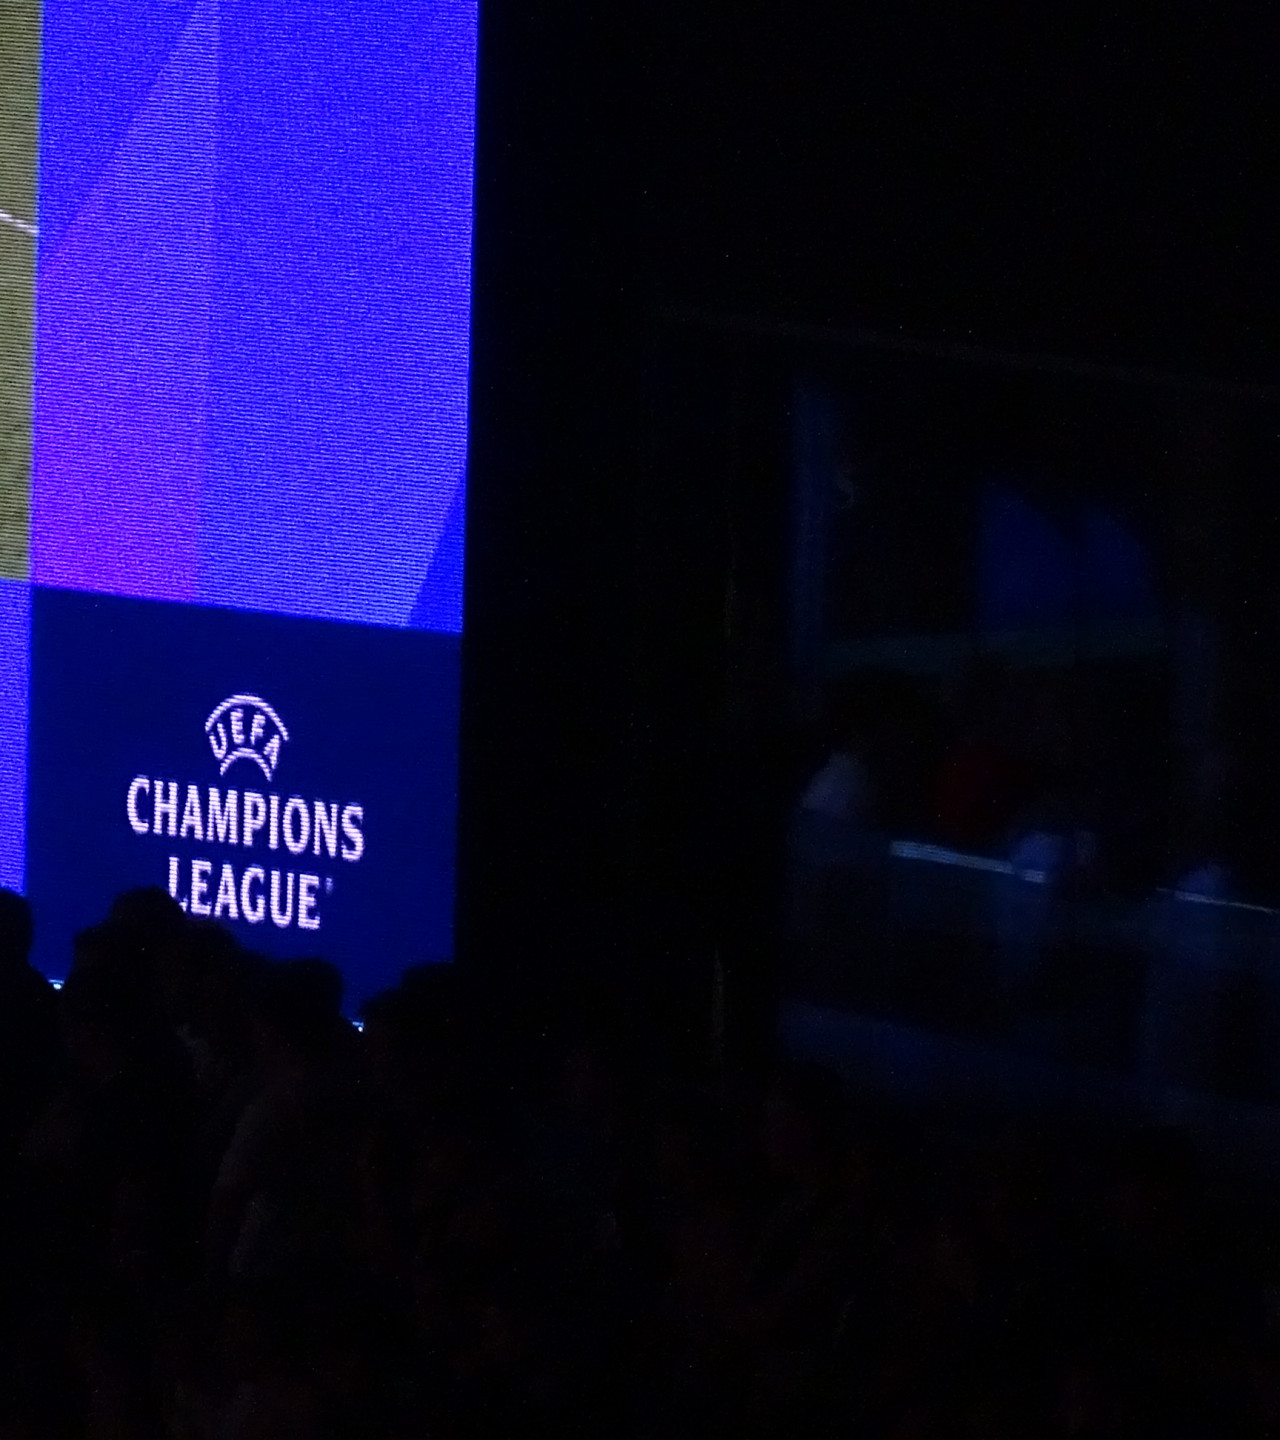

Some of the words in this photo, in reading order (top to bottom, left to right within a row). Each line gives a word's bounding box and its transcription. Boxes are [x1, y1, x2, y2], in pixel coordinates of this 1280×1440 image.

[208, 708, 282, 770] UEFA
[126, 774, 366, 862] CHAMPIONS
[168, 855, 322, 931] LEAGUE
